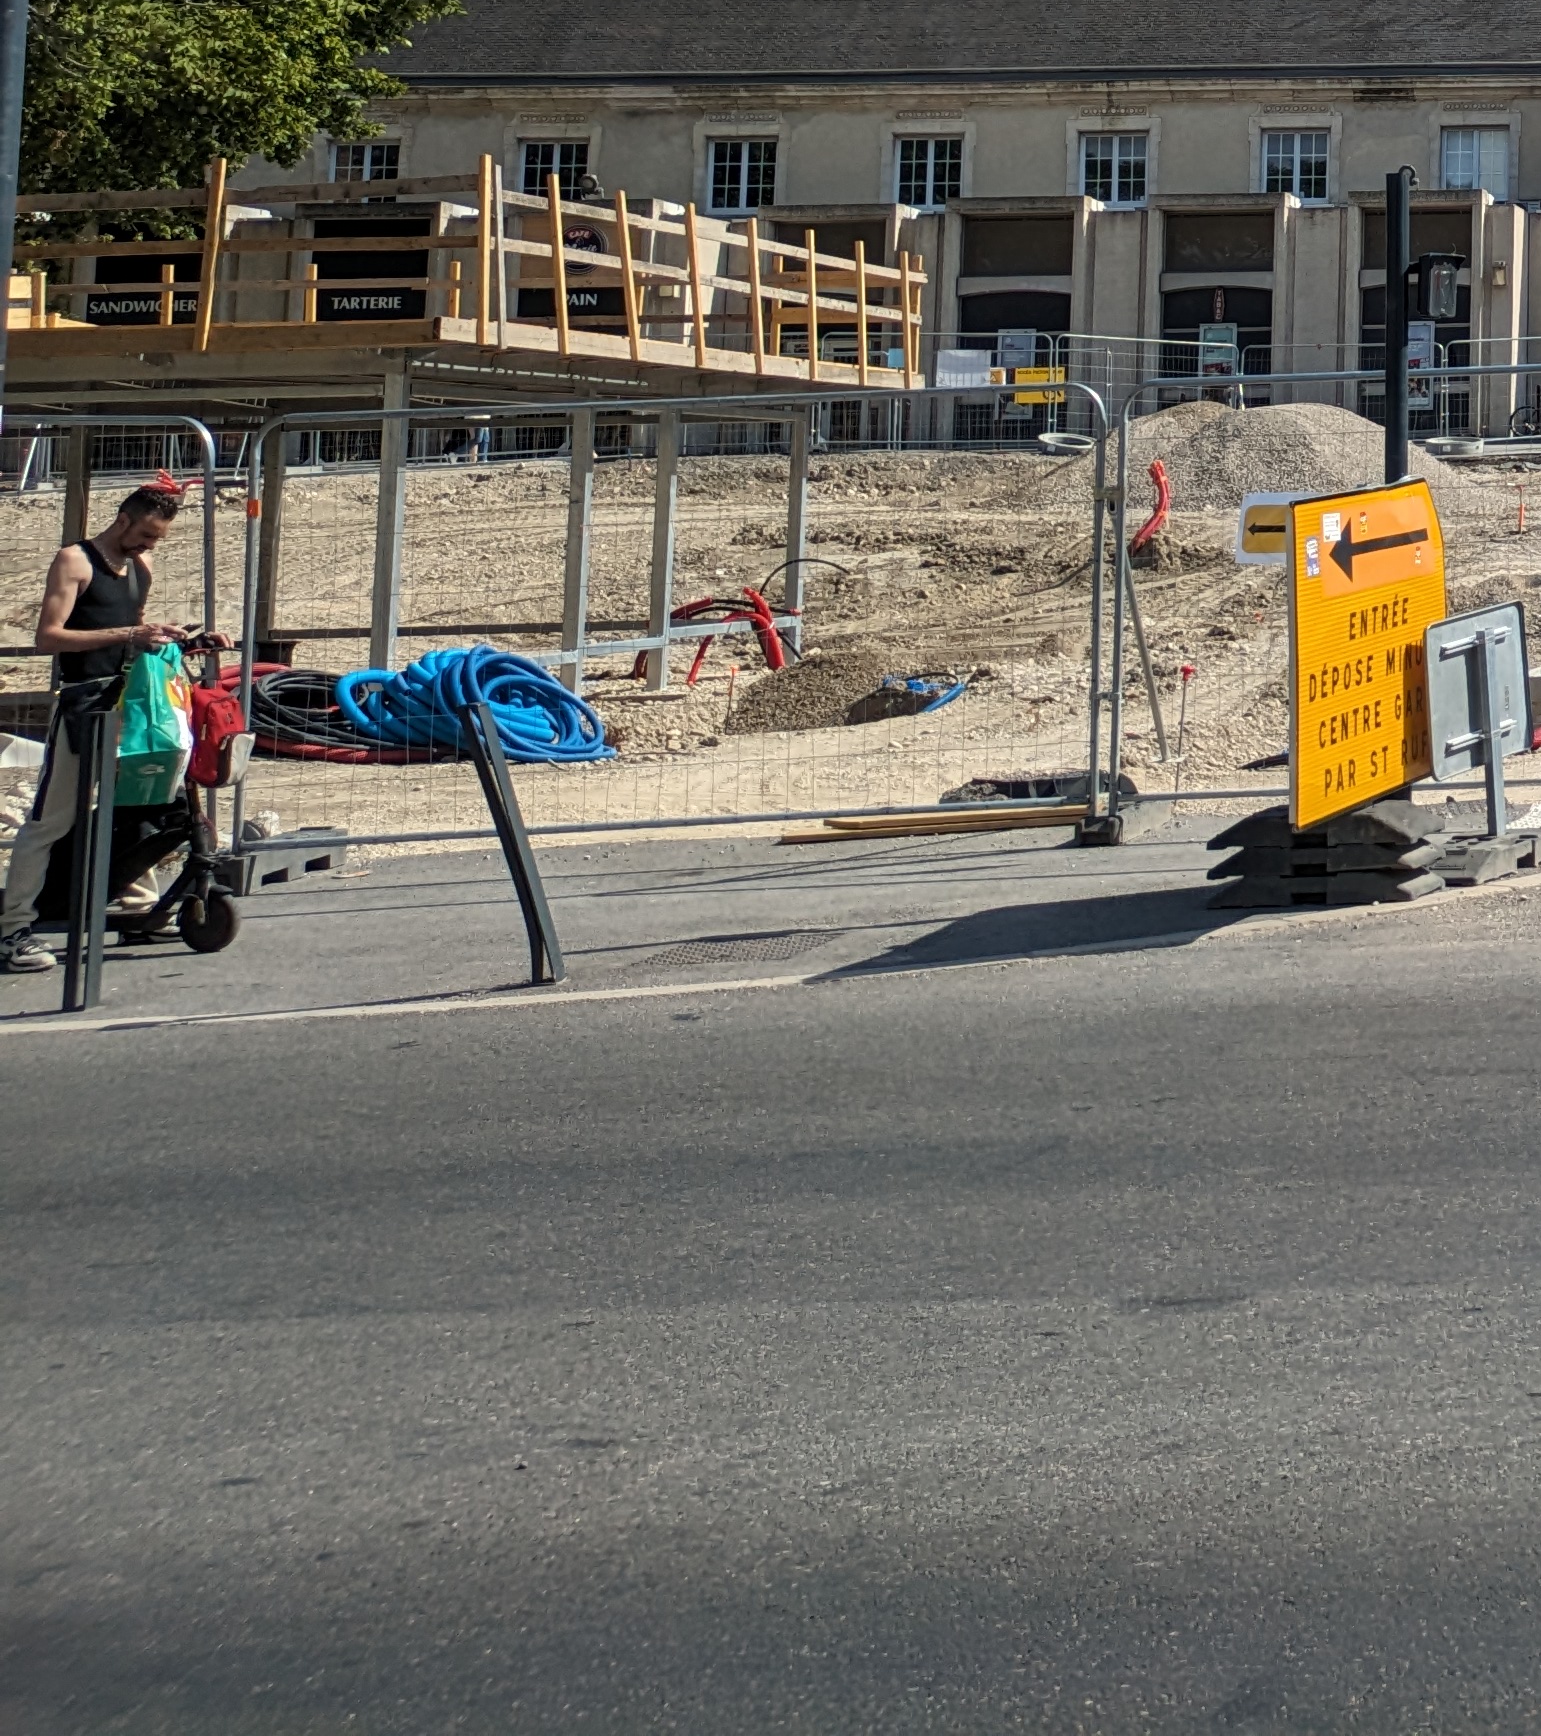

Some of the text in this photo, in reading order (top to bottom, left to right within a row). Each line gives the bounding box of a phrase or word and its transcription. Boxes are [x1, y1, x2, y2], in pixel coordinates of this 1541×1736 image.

[331, 296, 402, 311] TARTERIE
[1349, 594, 1409, 641] ENTRÉE
[1309, 639, 1423, 703] DÉPOSE MINU
[1319, 686, 1423, 749] CENTRE GAR
[1324, 759, 1356, 797] PAR
[1370, 745, 1388, 777] ST
